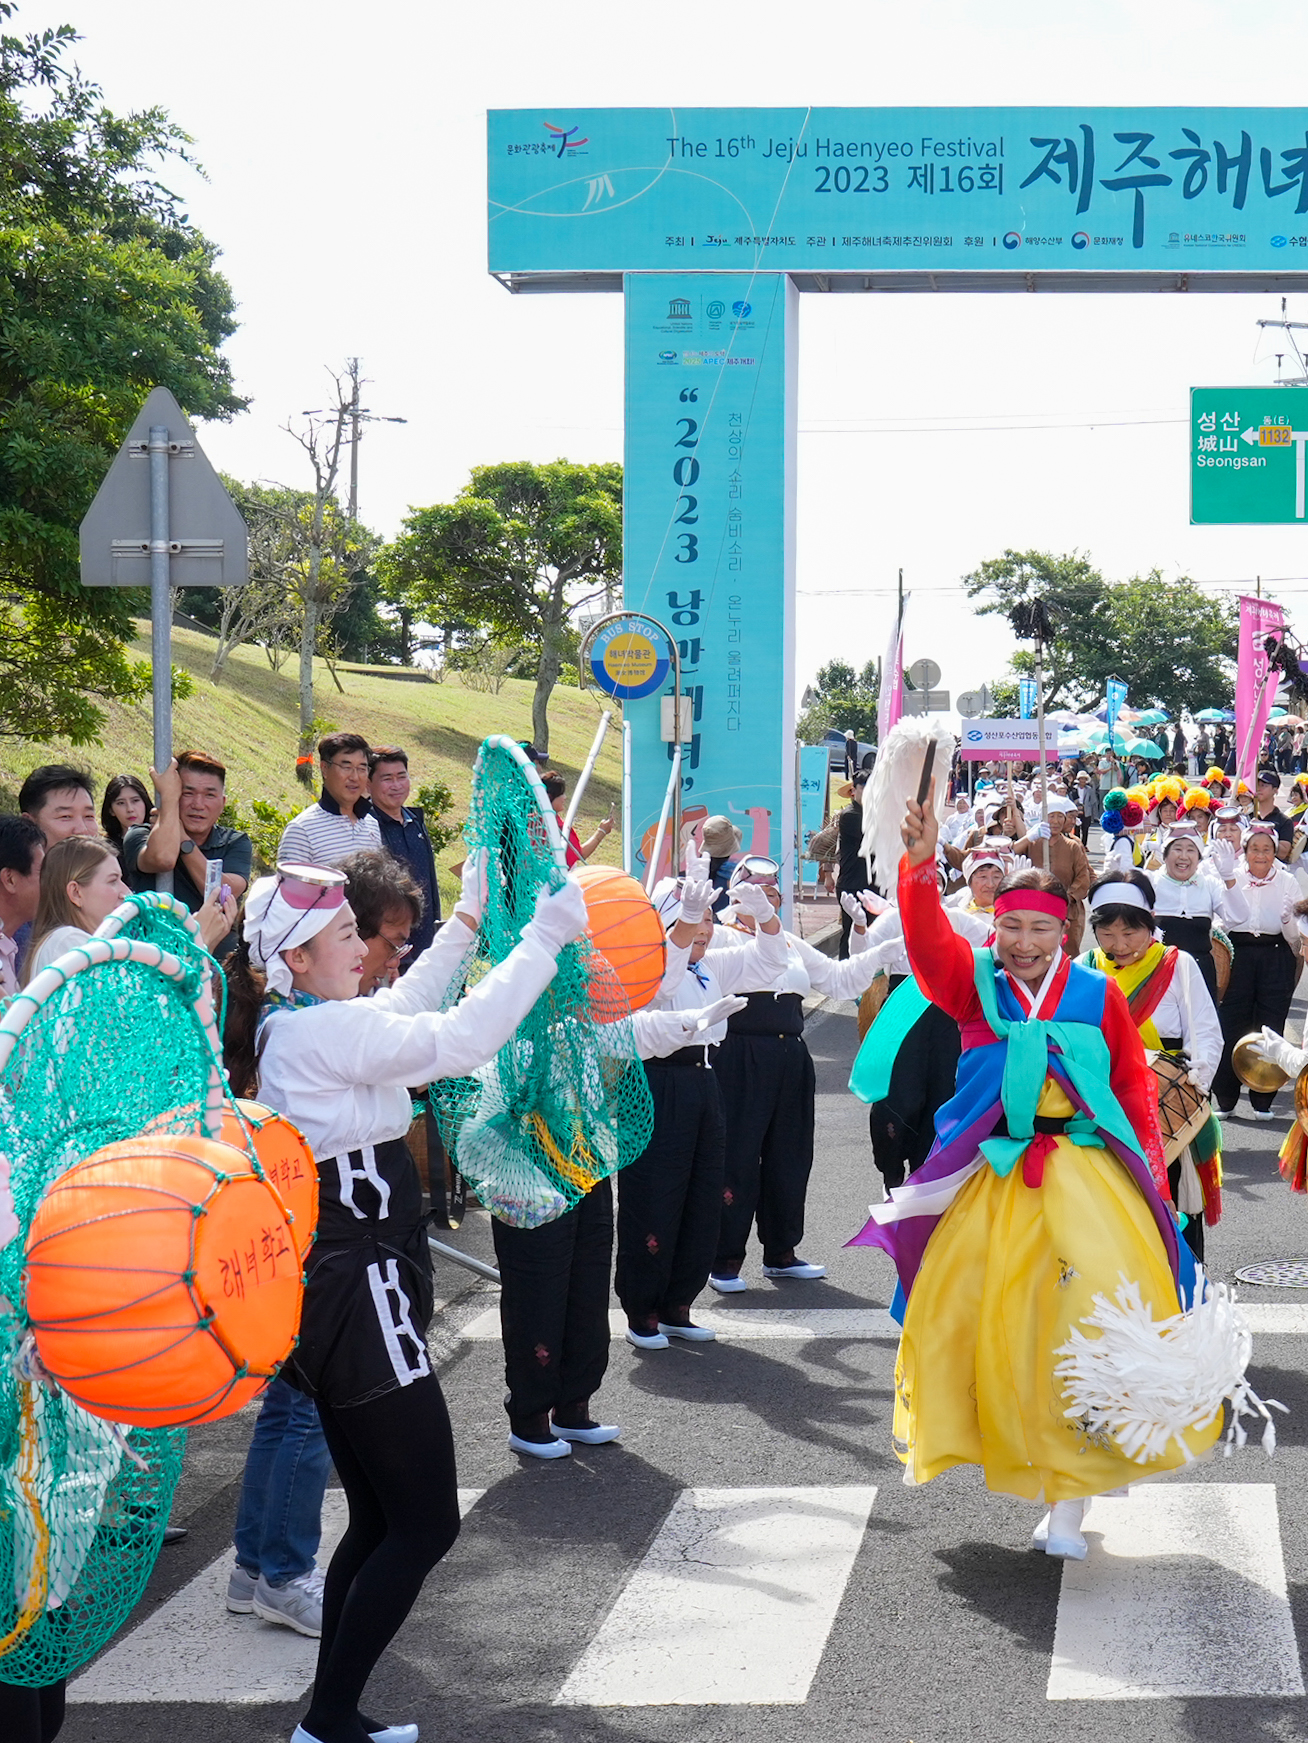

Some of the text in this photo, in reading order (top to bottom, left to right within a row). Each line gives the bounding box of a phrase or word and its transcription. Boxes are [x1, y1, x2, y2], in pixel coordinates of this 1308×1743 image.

[507, 142, 556, 156] 문화관광축제
[666, 134, 1005, 163] The 16th Jeju Haenyeo Festival
[814, 163, 1004, 196] 2023 제16회
[665, 236, 685, 247] 주최
[734, 236, 796, 247] 제주특별자치도
[806, 236, 953, 247] 주관 제주해녀축제추진위원회
[964, 236, 984, 247] 후원
[1025, 236, 1063, 246] 해양수산부
[1093, 236, 1124, 246] 문화재청
[1197, 411, 1241, 431] 성산
[1263, 415, 1290, 425] 동(E)
[728, 412, 742, 461] 천상의
[1198, 435, 1239, 452] 城山
[1260, 429, 1290, 443] 1132
[1197, 455, 1267, 469] Seongsan
[728, 469, 742, 500] 소리
[727, 595, 742, 643] 온누리
[600, 621, 659, 644] BUS STOP
[609, 649, 651, 660] 해녀박물관
[726, 650, 742, 732] 울려퍼지다
[984, 731, 1052, 740] 성산포수산업협동합
